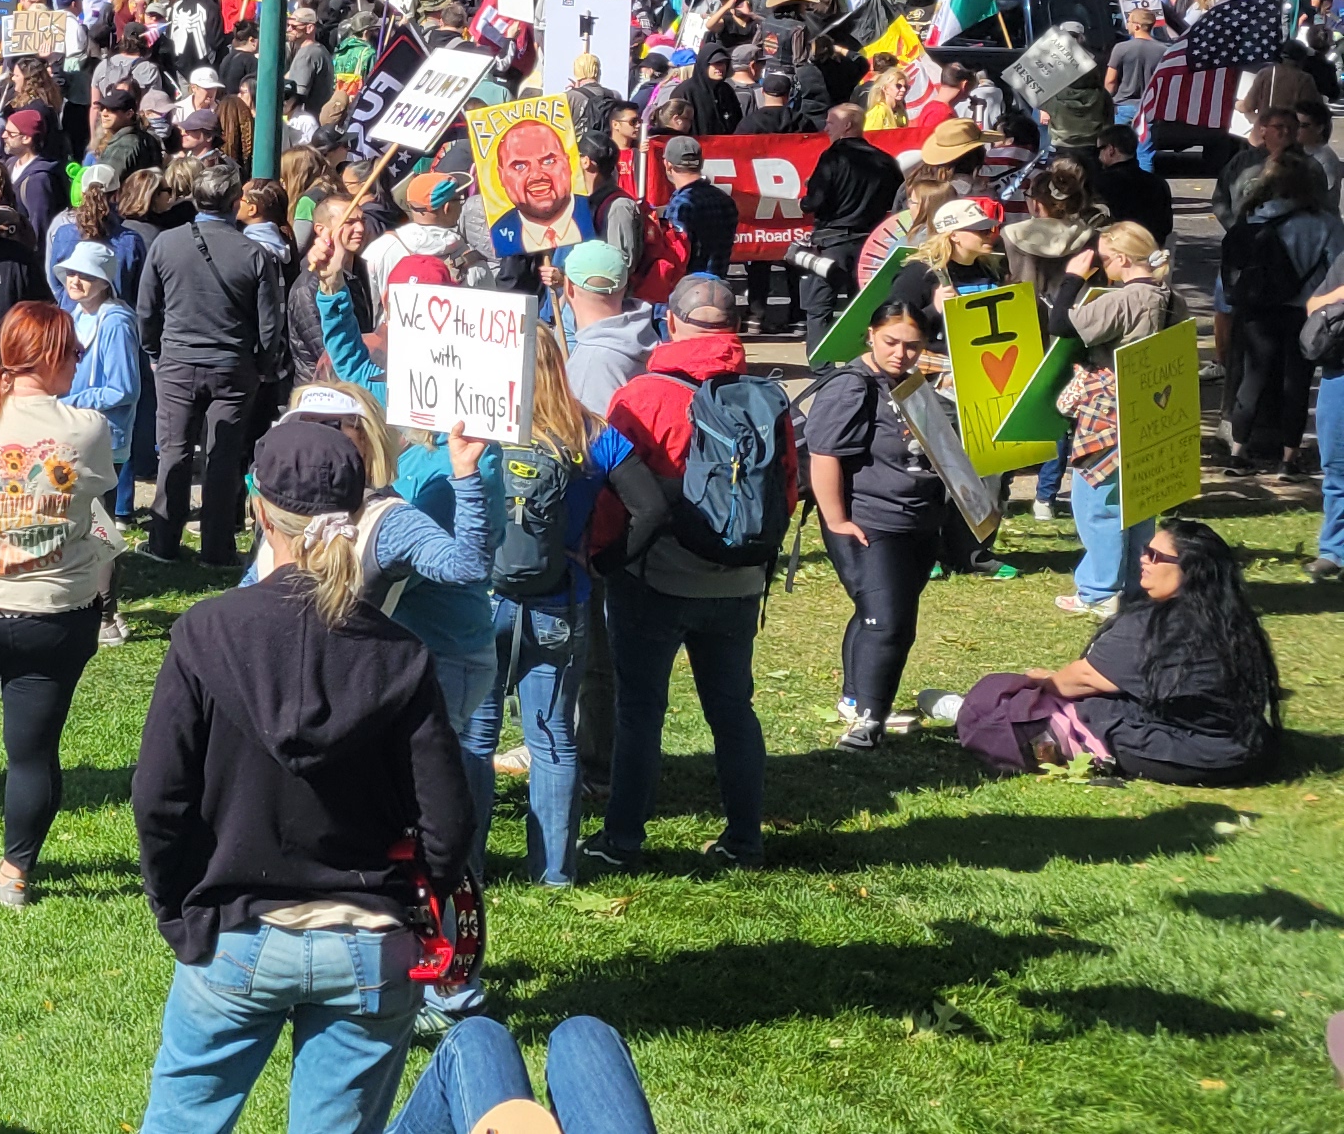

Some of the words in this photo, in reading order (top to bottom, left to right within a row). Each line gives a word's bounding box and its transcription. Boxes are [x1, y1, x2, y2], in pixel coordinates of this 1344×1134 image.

[1131, 0, 1150, 9] TO
[14, 12, 66, 33] FUCK
[13, 32, 65, 53] TRUMP
[413, 69, 469, 99] DUMP
[1013, 62, 1046, 96] RESIST
[384, 101, 445, 133] TRUMP
[472, 100, 566, 159] BEWARE
[755, 230, 791, 243] Road
[394, 291, 425, 330] We
[453, 304, 476, 338] the
[965, 291, 1018, 347] I
[430, 345, 461, 370] with
[1121, 346, 1151, 378] HERE
[1139, 356, 1185, 391] BECAUSE
[410, 369, 438, 410] NO
[455, 378, 516, 432] Kings!
[1128, 400, 1139, 425] I
[1139, 408, 1188, 443] AMERICA
